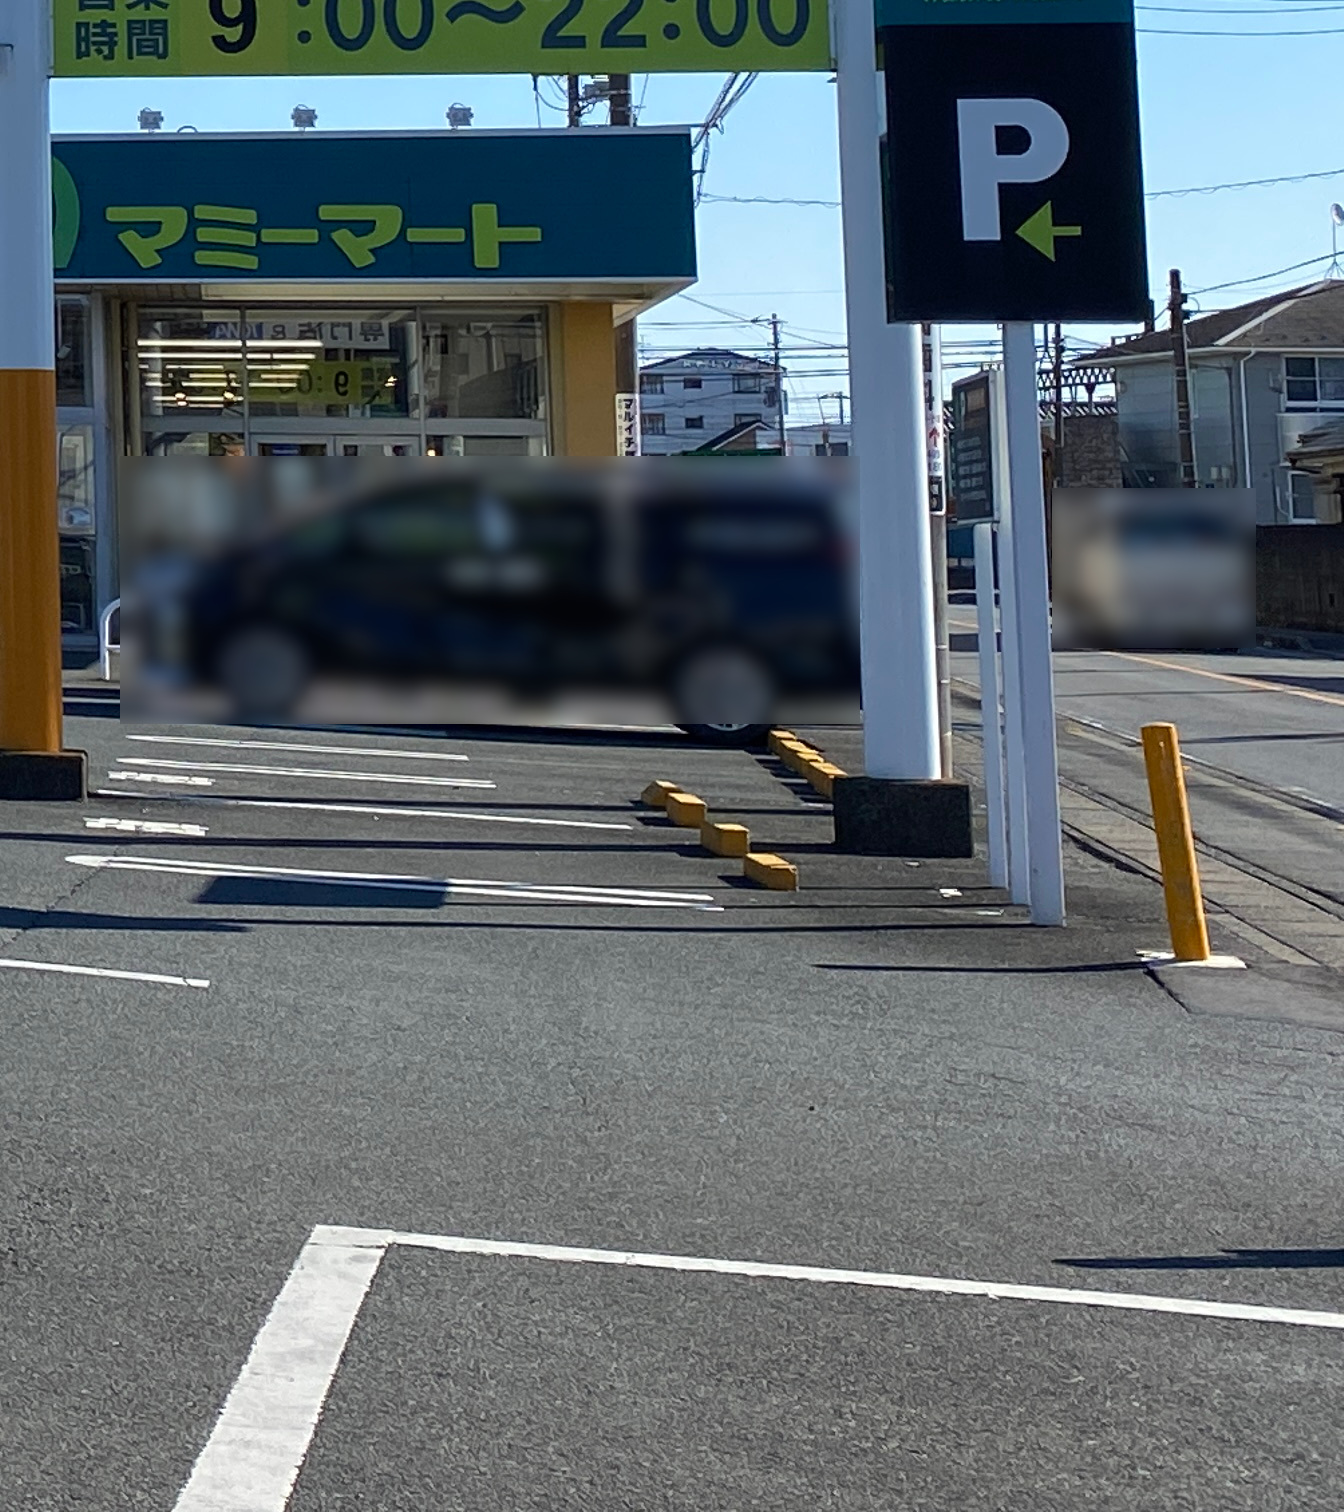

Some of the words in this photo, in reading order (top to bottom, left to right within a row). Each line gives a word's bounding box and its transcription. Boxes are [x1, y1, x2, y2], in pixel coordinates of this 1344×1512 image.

[74, 18, 170, 61] 時間
[957, 97, 1070, 242] P
[105, 202, 543, 271] マミーマート
